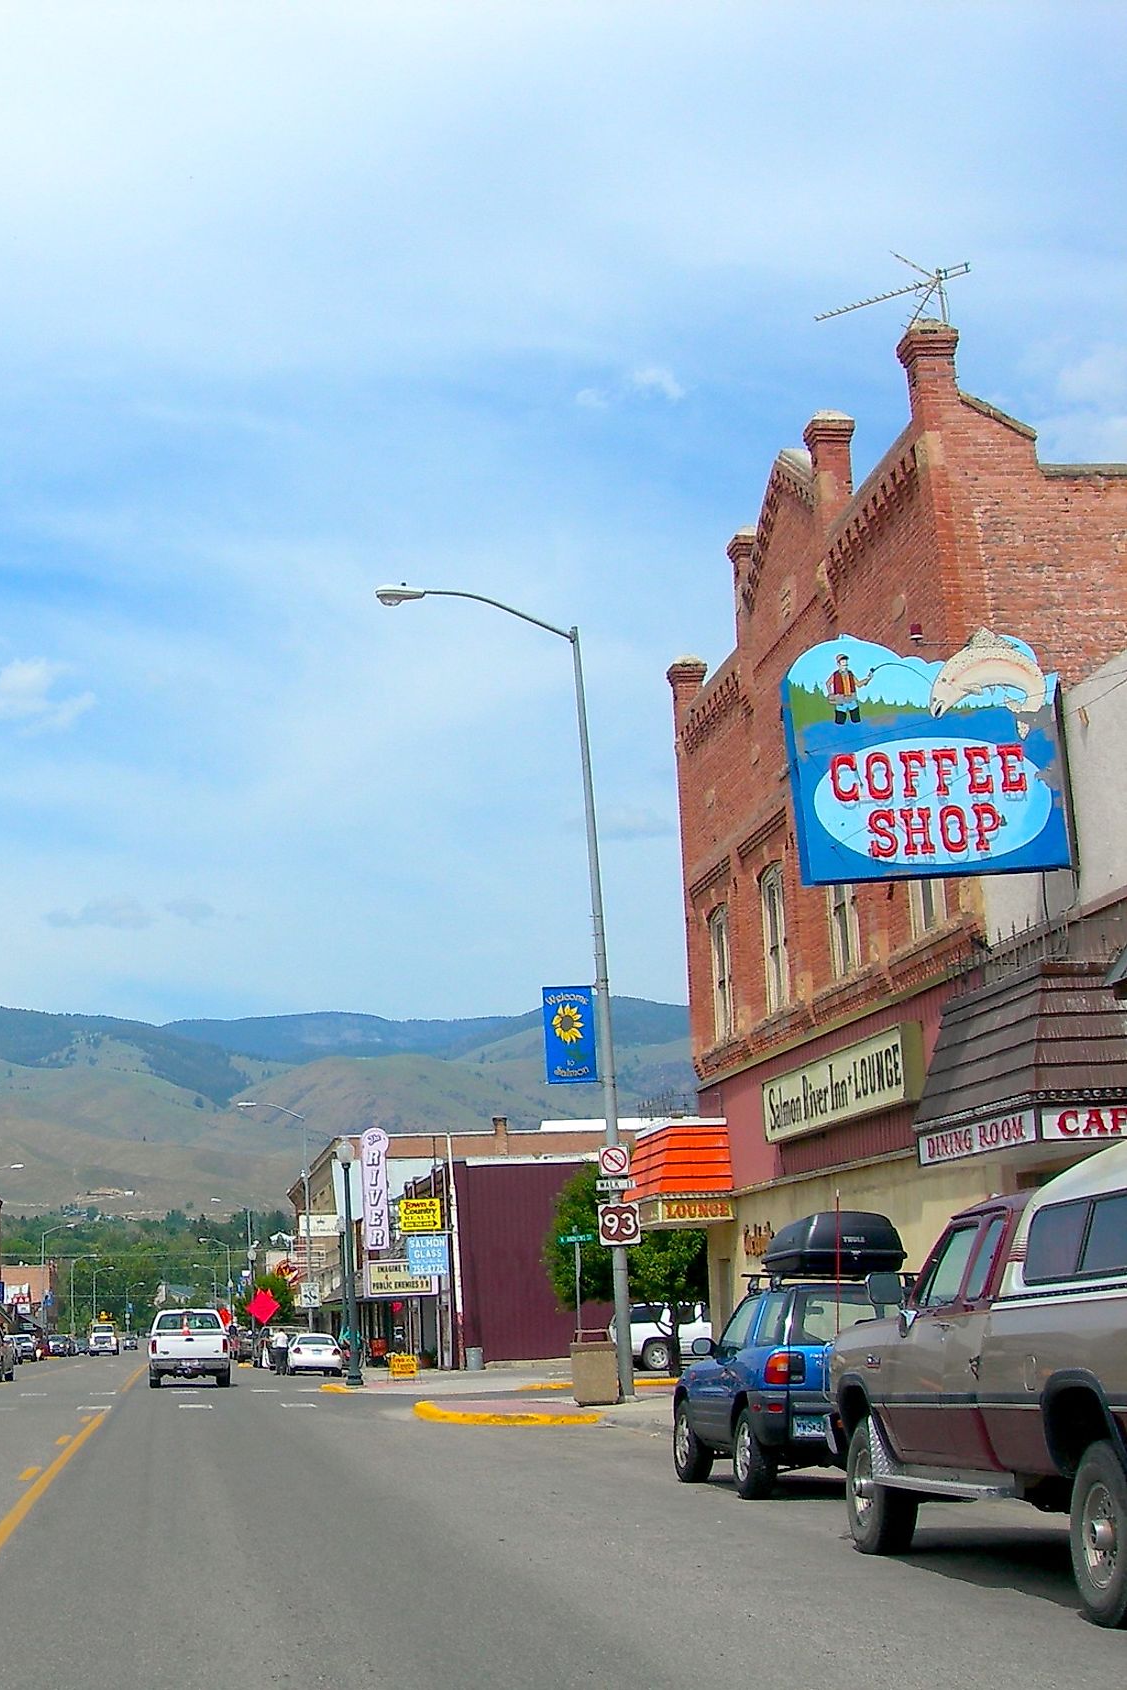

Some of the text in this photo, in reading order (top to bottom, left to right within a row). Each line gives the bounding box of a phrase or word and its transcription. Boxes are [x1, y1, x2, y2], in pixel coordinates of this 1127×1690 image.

[830, 743, 1028, 802] COFFEE
[868, 802, 1002, 859] SHOP
[545, 993, 589, 1006] Welcome
[554, 1066, 590, 1077] Salmon
[566, 1059, 575, 1067] to
[768, 1043, 902, 1131] Salmon River Inn LOUNGE
[1057, 1107, 1127, 1136] CAF
[926, 1115, 1026, 1159] DINING ROOM
[366, 1150, 385, 1247] RIVER
[665, 1202, 730, 1218] LOUNGE
[604, 1212, 636, 1236] 93
[409, 1238, 445, 1249] SALMON
[414, 1249, 442, 1259] GLASS
[373, 1281, 393, 1290] PUBLIC
[394, 1280, 419, 1289] ENEMIES
